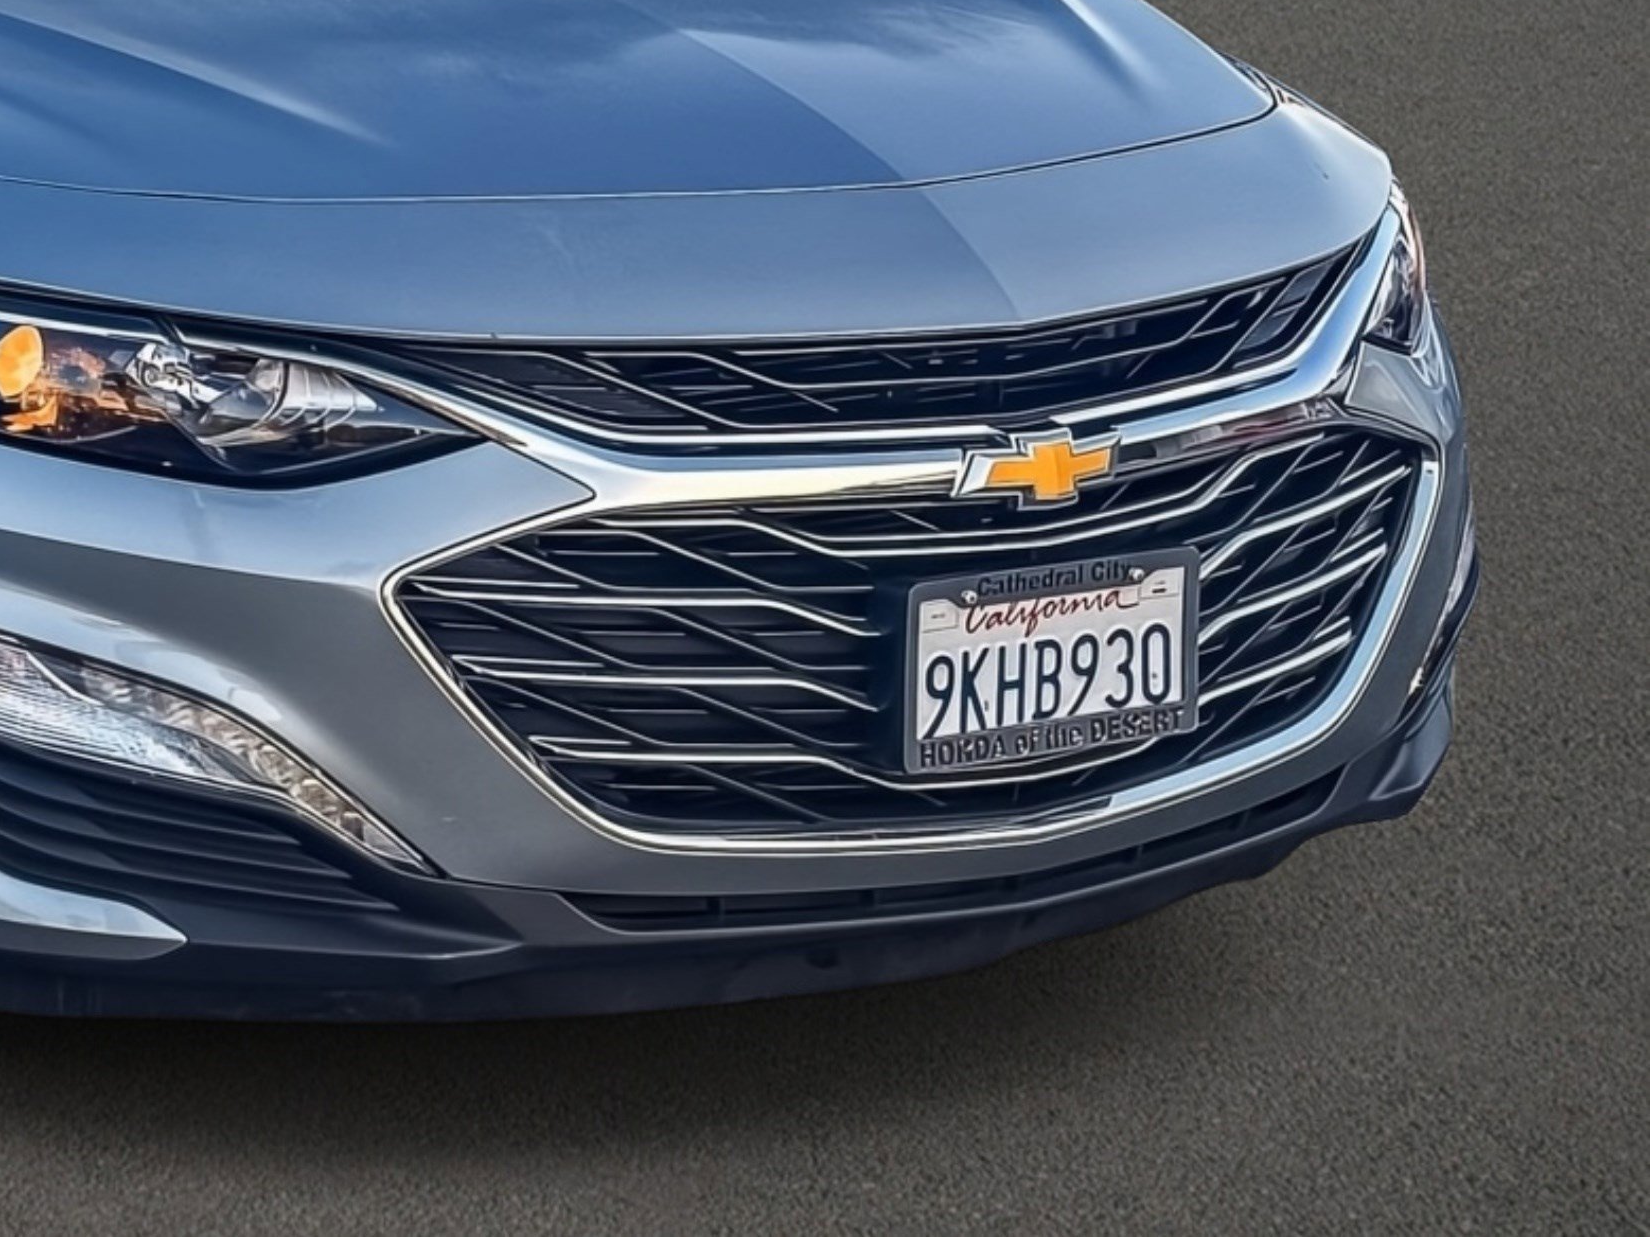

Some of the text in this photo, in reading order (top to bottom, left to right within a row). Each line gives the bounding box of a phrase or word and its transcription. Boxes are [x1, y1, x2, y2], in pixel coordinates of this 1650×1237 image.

[977, 560, 1131, 596] Cathedral City
[965, 590, 1140, 637] California
[921, 623, 1171, 740] 9KHB930
[919, 708, 1185, 767] HONDA of the DESERT
